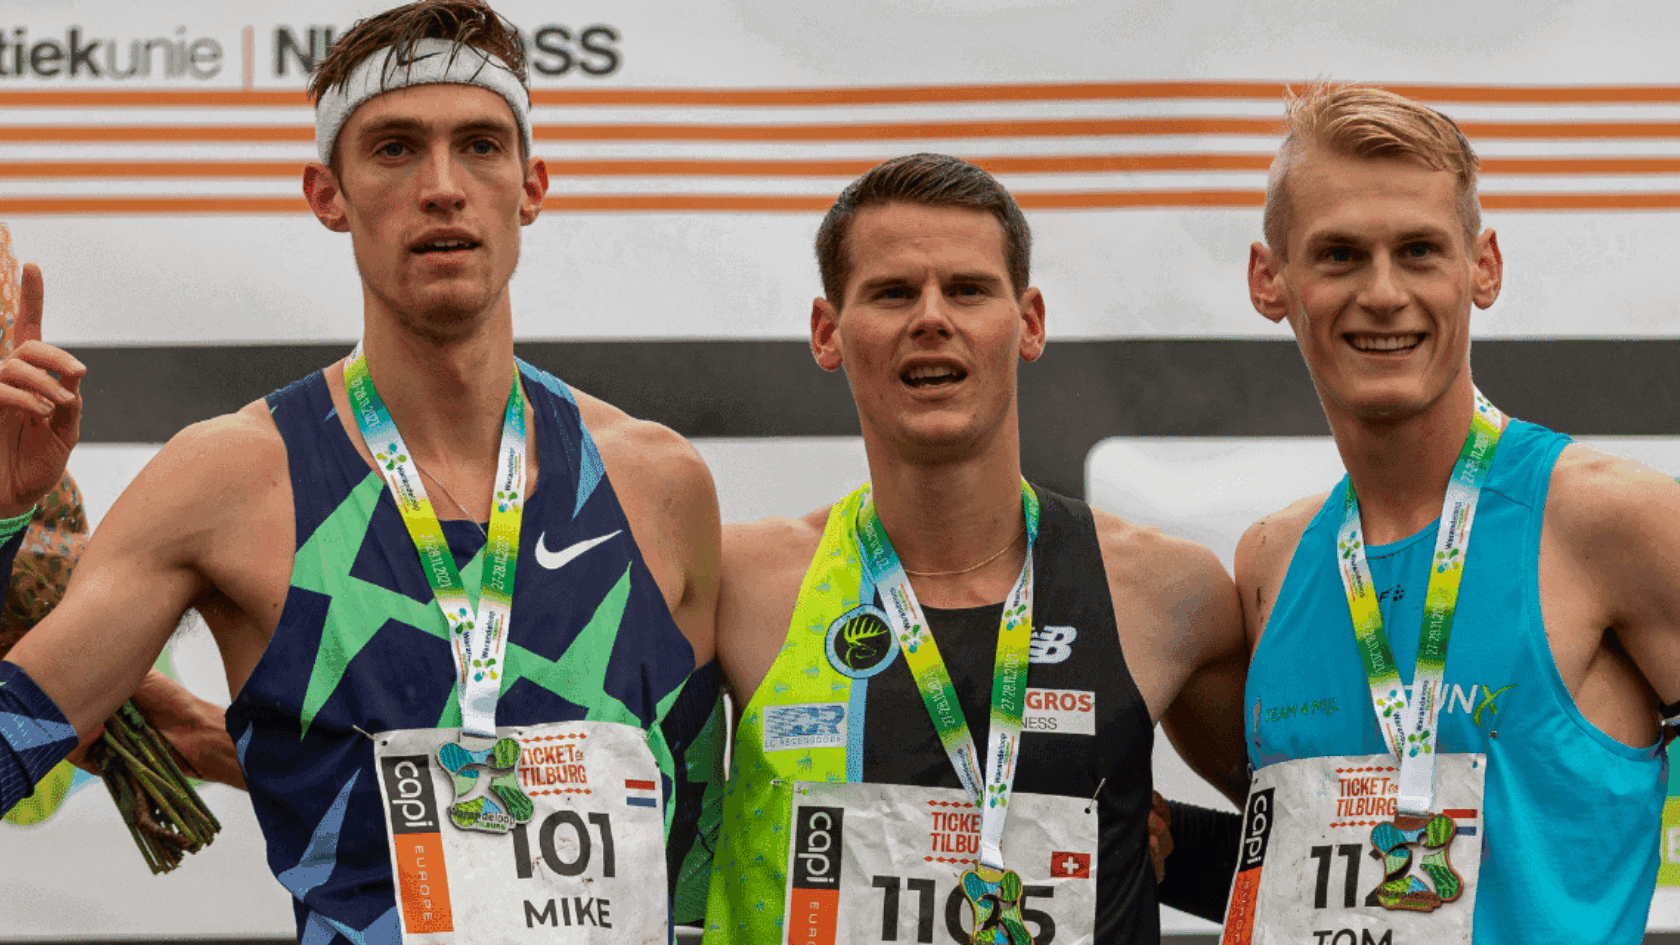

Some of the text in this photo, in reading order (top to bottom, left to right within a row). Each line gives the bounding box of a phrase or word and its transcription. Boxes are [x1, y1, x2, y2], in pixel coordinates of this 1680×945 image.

[532, 25, 620, 75] SS
[1025, 690, 1094, 713] GROS
[1021, 717, 1058, 731] NESS
[521, 744, 576, 767] TICKET
[519, 765, 587, 787] TILBURG
[1338, 777, 1391, 798] TICKET
[1337, 797, 1397, 817] TILBURG
[931, 811, 981, 833] TICKE
[511, 810, 616, 879] 101
[930, 832, 979, 854] TILBU
[523, 897, 612, 929] MIKE
